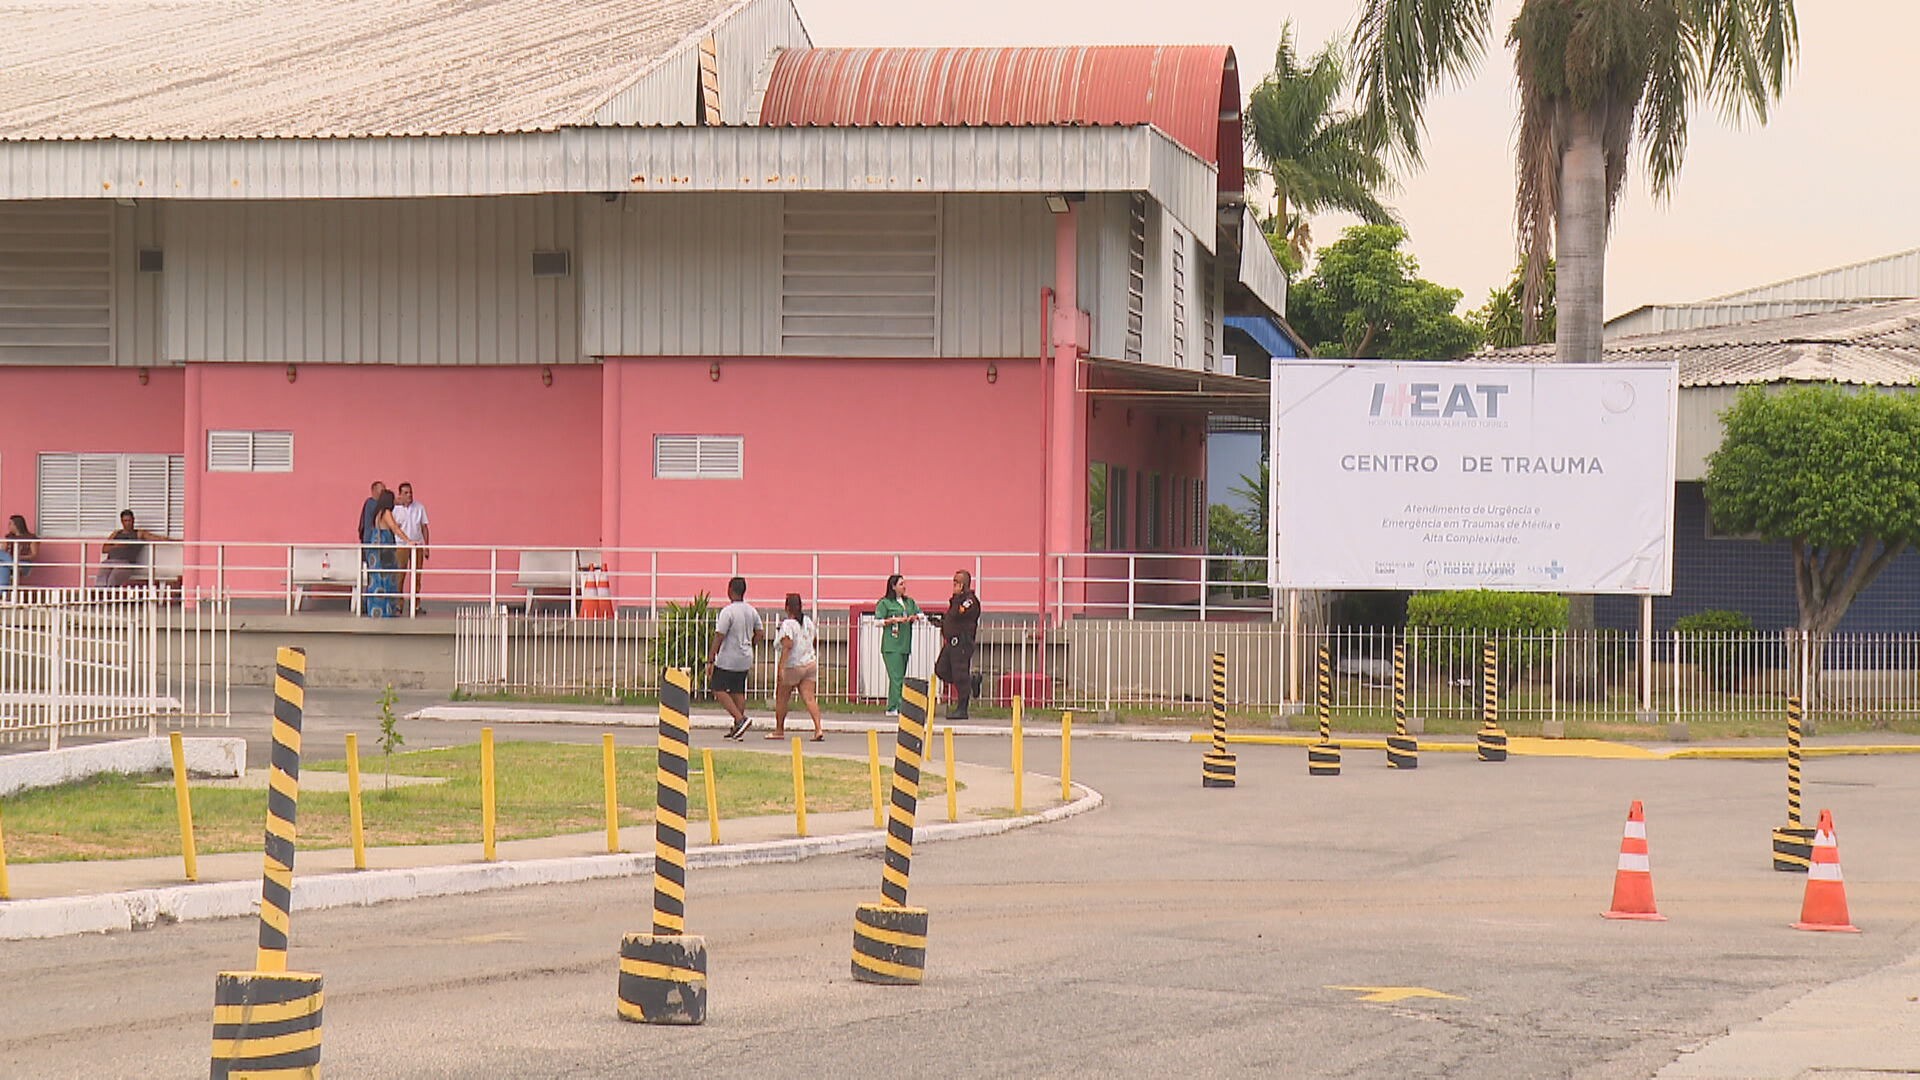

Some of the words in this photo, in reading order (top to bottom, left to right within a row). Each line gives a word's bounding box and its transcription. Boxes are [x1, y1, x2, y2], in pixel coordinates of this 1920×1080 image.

[1341, 455, 1438, 472] CENTRO
[1462, 456, 1493, 472] DE
[1501, 457, 1604, 473] TRAUMA
[1404, 504, 1471, 515] Atendimento
[1487, 505, 1532, 517] Urgência
[1534, 507, 1541, 515] e
[1382, 518, 1441, 530] Emergência
[1443, 520, 1460, 529] em
[1462, 520, 1505, 529] Traumas
[1507, 520, 1520, 529] de
[1522, 520, 1552, 529] Média
[1554, 522, 1561, 530] e
[1423, 533, 1444, 543] Alta
[1446, 534, 1520, 545] Complexidade.
[1444, 567, 1460, 575] RIO
[1462, 567, 1474, 575] DE
[1477, 567, 1516, 576] JANEIRO
